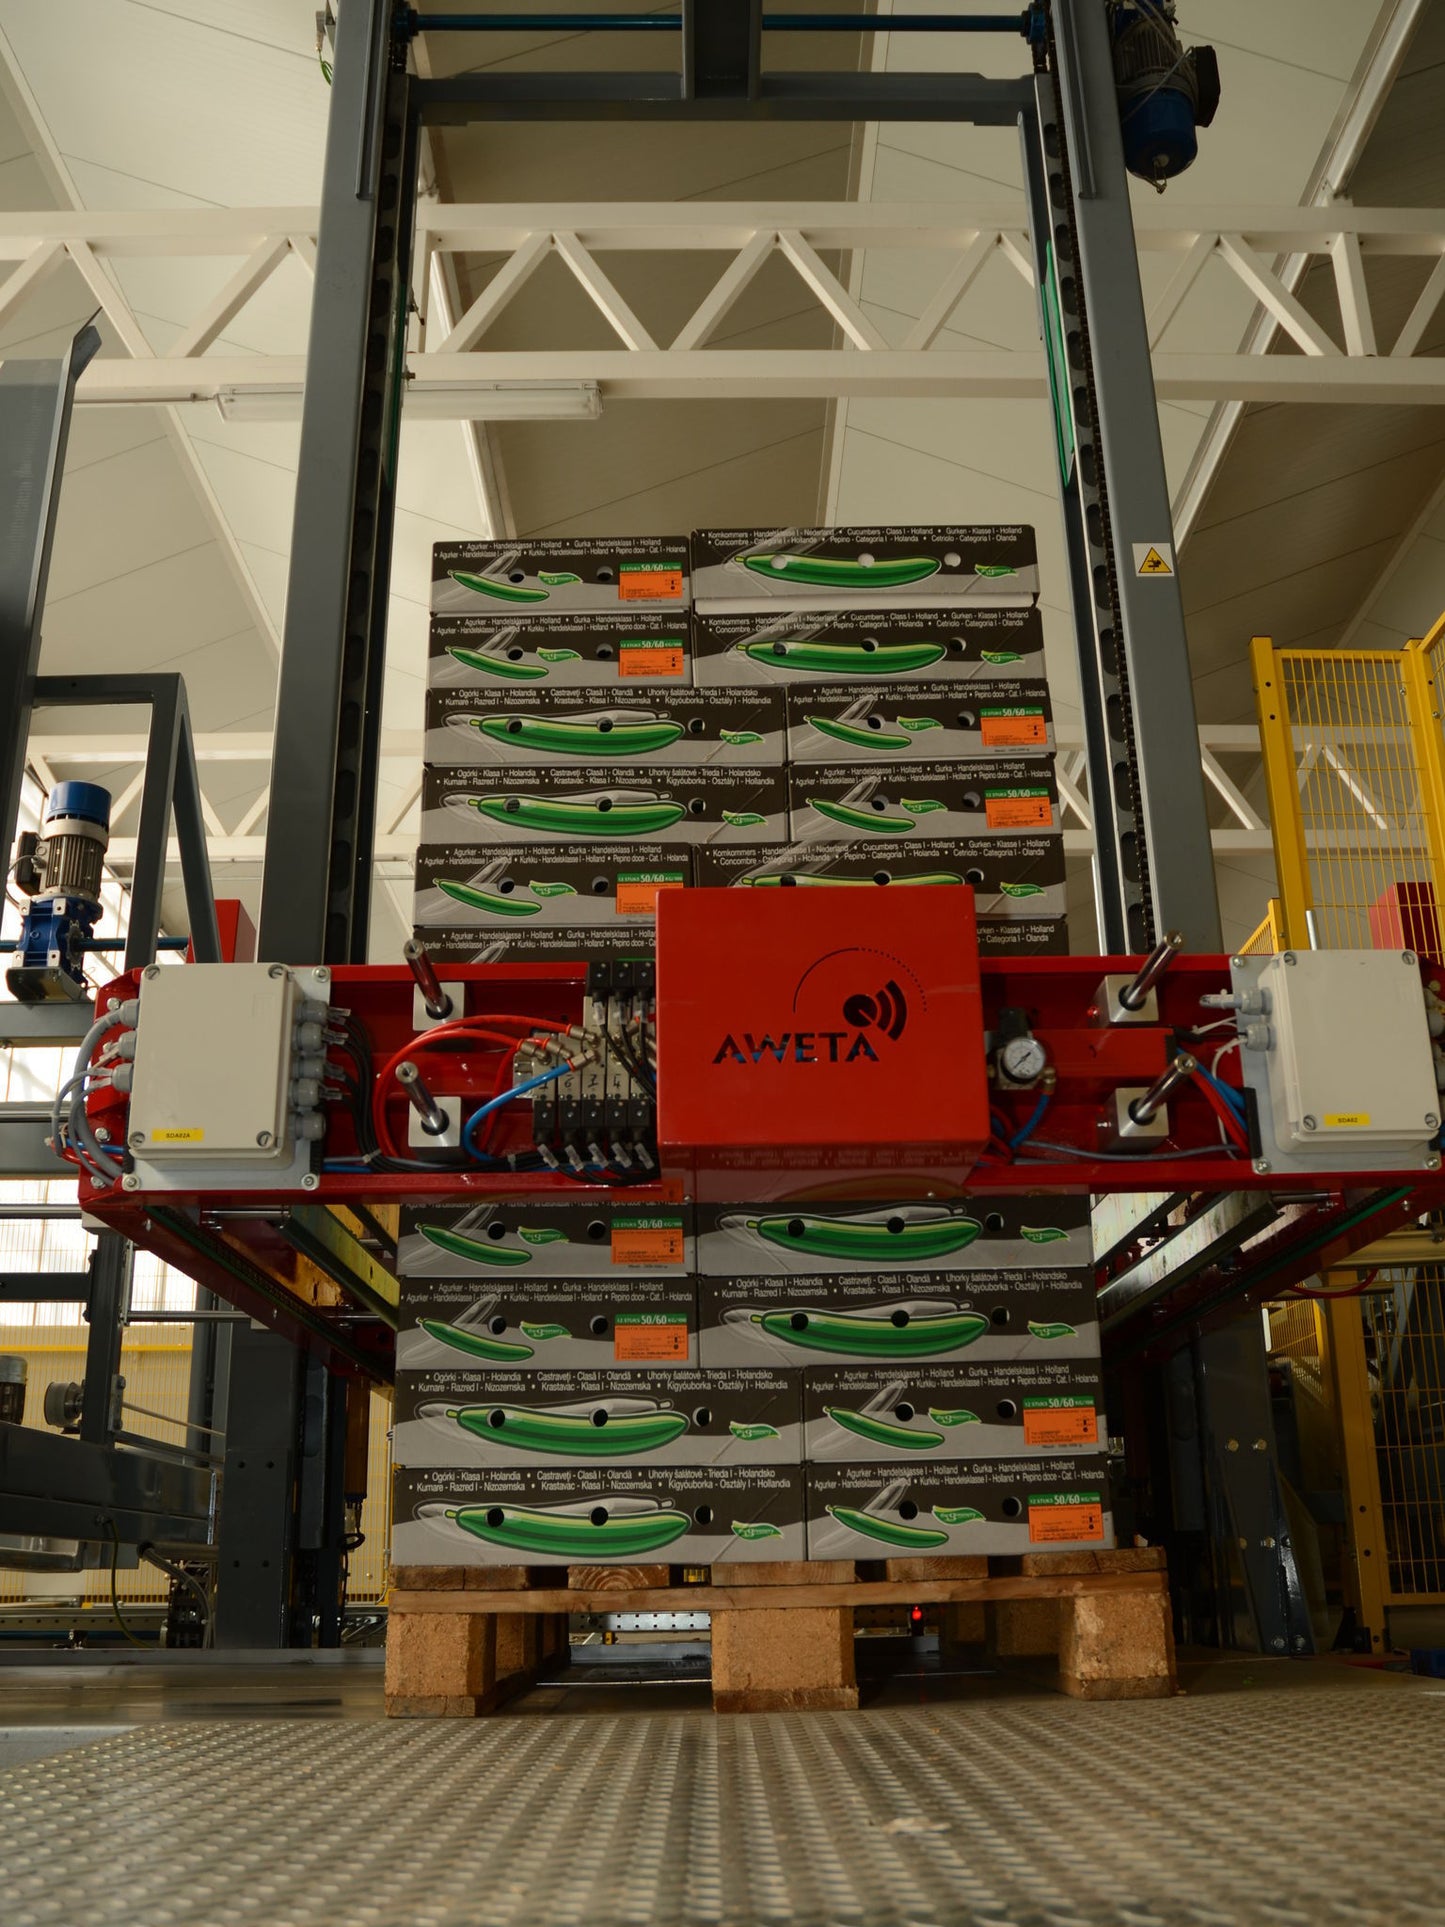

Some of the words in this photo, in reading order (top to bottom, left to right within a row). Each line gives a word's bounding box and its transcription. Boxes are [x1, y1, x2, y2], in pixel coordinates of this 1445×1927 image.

[846, 528, 881, 536] Cucumbers
[972, 527, 991, 535] Klasse
[829, 536, 851, 544] Pepino
[855, 536, 884, 544] Categoria
[894, 535, 919, 543] Holanda
[959, 535, 988, 544] Categoria
[466, 543, 488, 552] Agurker
[540, 541, 562, 549] Holland
[574, 540, 591, 548] Gurka
[642, 564, 663, 572] 50/60
[642, 640, 664, 648] 50/60
[458, 690, 479, 699] Ogórki
[509, 689, 537, 697] Holandia
[647, 689, 669, 698] Uhorky
[1003, 707, 1025, 716] 50/60
[1008, 790, 1030, 798] 50/60
[862, 843, 899, 851] Cucumbers
[904, 842, 922, 850] Class
[931, 841, 955, 849] Holland
[996, 840, 1017, 848] Klasse
[1026, 840, 1050, 848] Holland
[843, 852, 866, 862] Pepino
[871, 851, 902, 861] Categoria
[913, 849, 940, 858] Holanda
[953, 849, 978, 857] Cetriolo
[983, 849, 1013, 858] Categoria
[1022, 848, 1045, 856] Olanda
[641, 874, 664, 883] 50/60
[712, 1032, 880, 1064] AWETA
[638, 1220, 662, 1229] 50/60
[438, 1284, 463, 1295] Agurker
[523, 1283, 548, 1292] Holland
[562, 1283, 582, 1292] Gurka
[639, 1283, 663, 1292] Holland
[642, 1315, 666, 1324] 50/60
[843, 1371, 869, 1382] Agurker
[930, 1369, 954, 1378] Holland
[968, 1367, 988, 1377] Gurka
[1044, 1365, 1069, 1375] Holland
[812, 1382, 834, 1393] Agurker
[987, 1378, 1009, 1387] Holland
[1017, 1376, 1037, 1388] Pepino
[1037, 1376, 1052, 1385] doce
[1075, 1374, 1099, 1384] Holanda
[1049, 1398, 1074, 1408] 50/60
[432, 1472, 455, 1484] Ogórki
[461, 1472, 480, 1481] Klasa
[490, 1472, 521, 1481] Holandia
[648, 1470, 673, 1481] Uhorky
[709, 1469, 729, 1479] Trieda
[738, 1469, 775, 1478] Holandsko
[449, 1483, 474, 1492] Razred
[483, 1482, 525, 1492] Nizozemska
[581, 1481, 601, 1490] Klasa
[610, 1481, 652, 1490] Nizozemska
[757, 1479, 791, 1489] Hollandia
[1055, 1494, 1080, 1504] 50/60
